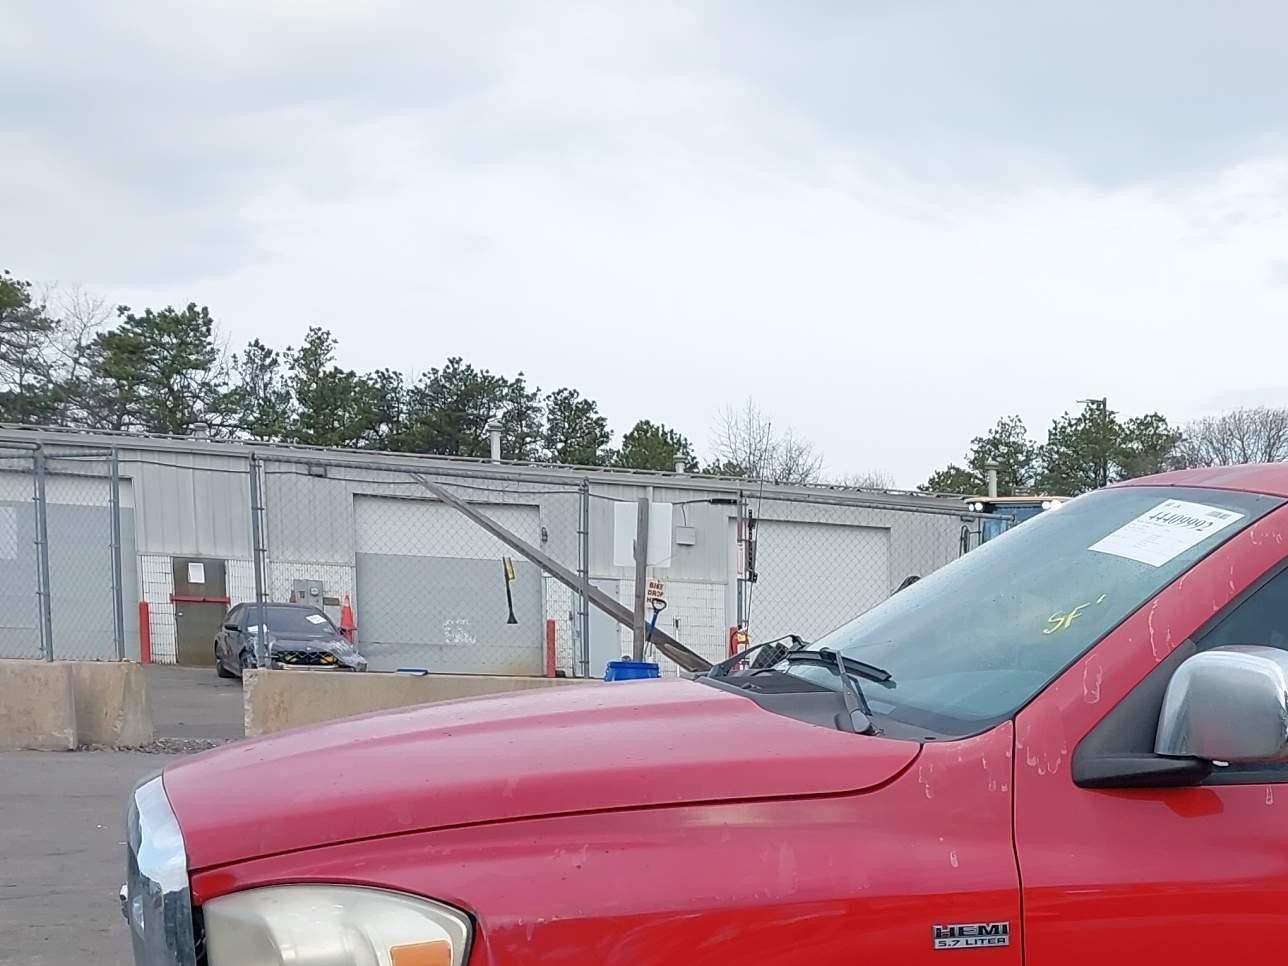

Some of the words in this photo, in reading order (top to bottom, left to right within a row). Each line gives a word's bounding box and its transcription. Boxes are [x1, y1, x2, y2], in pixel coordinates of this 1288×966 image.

[1149, 511, 1214, 532] 44409992
[935, 924, 1008, 938] HEMI
[965, 937, 1006, 946] LITER
